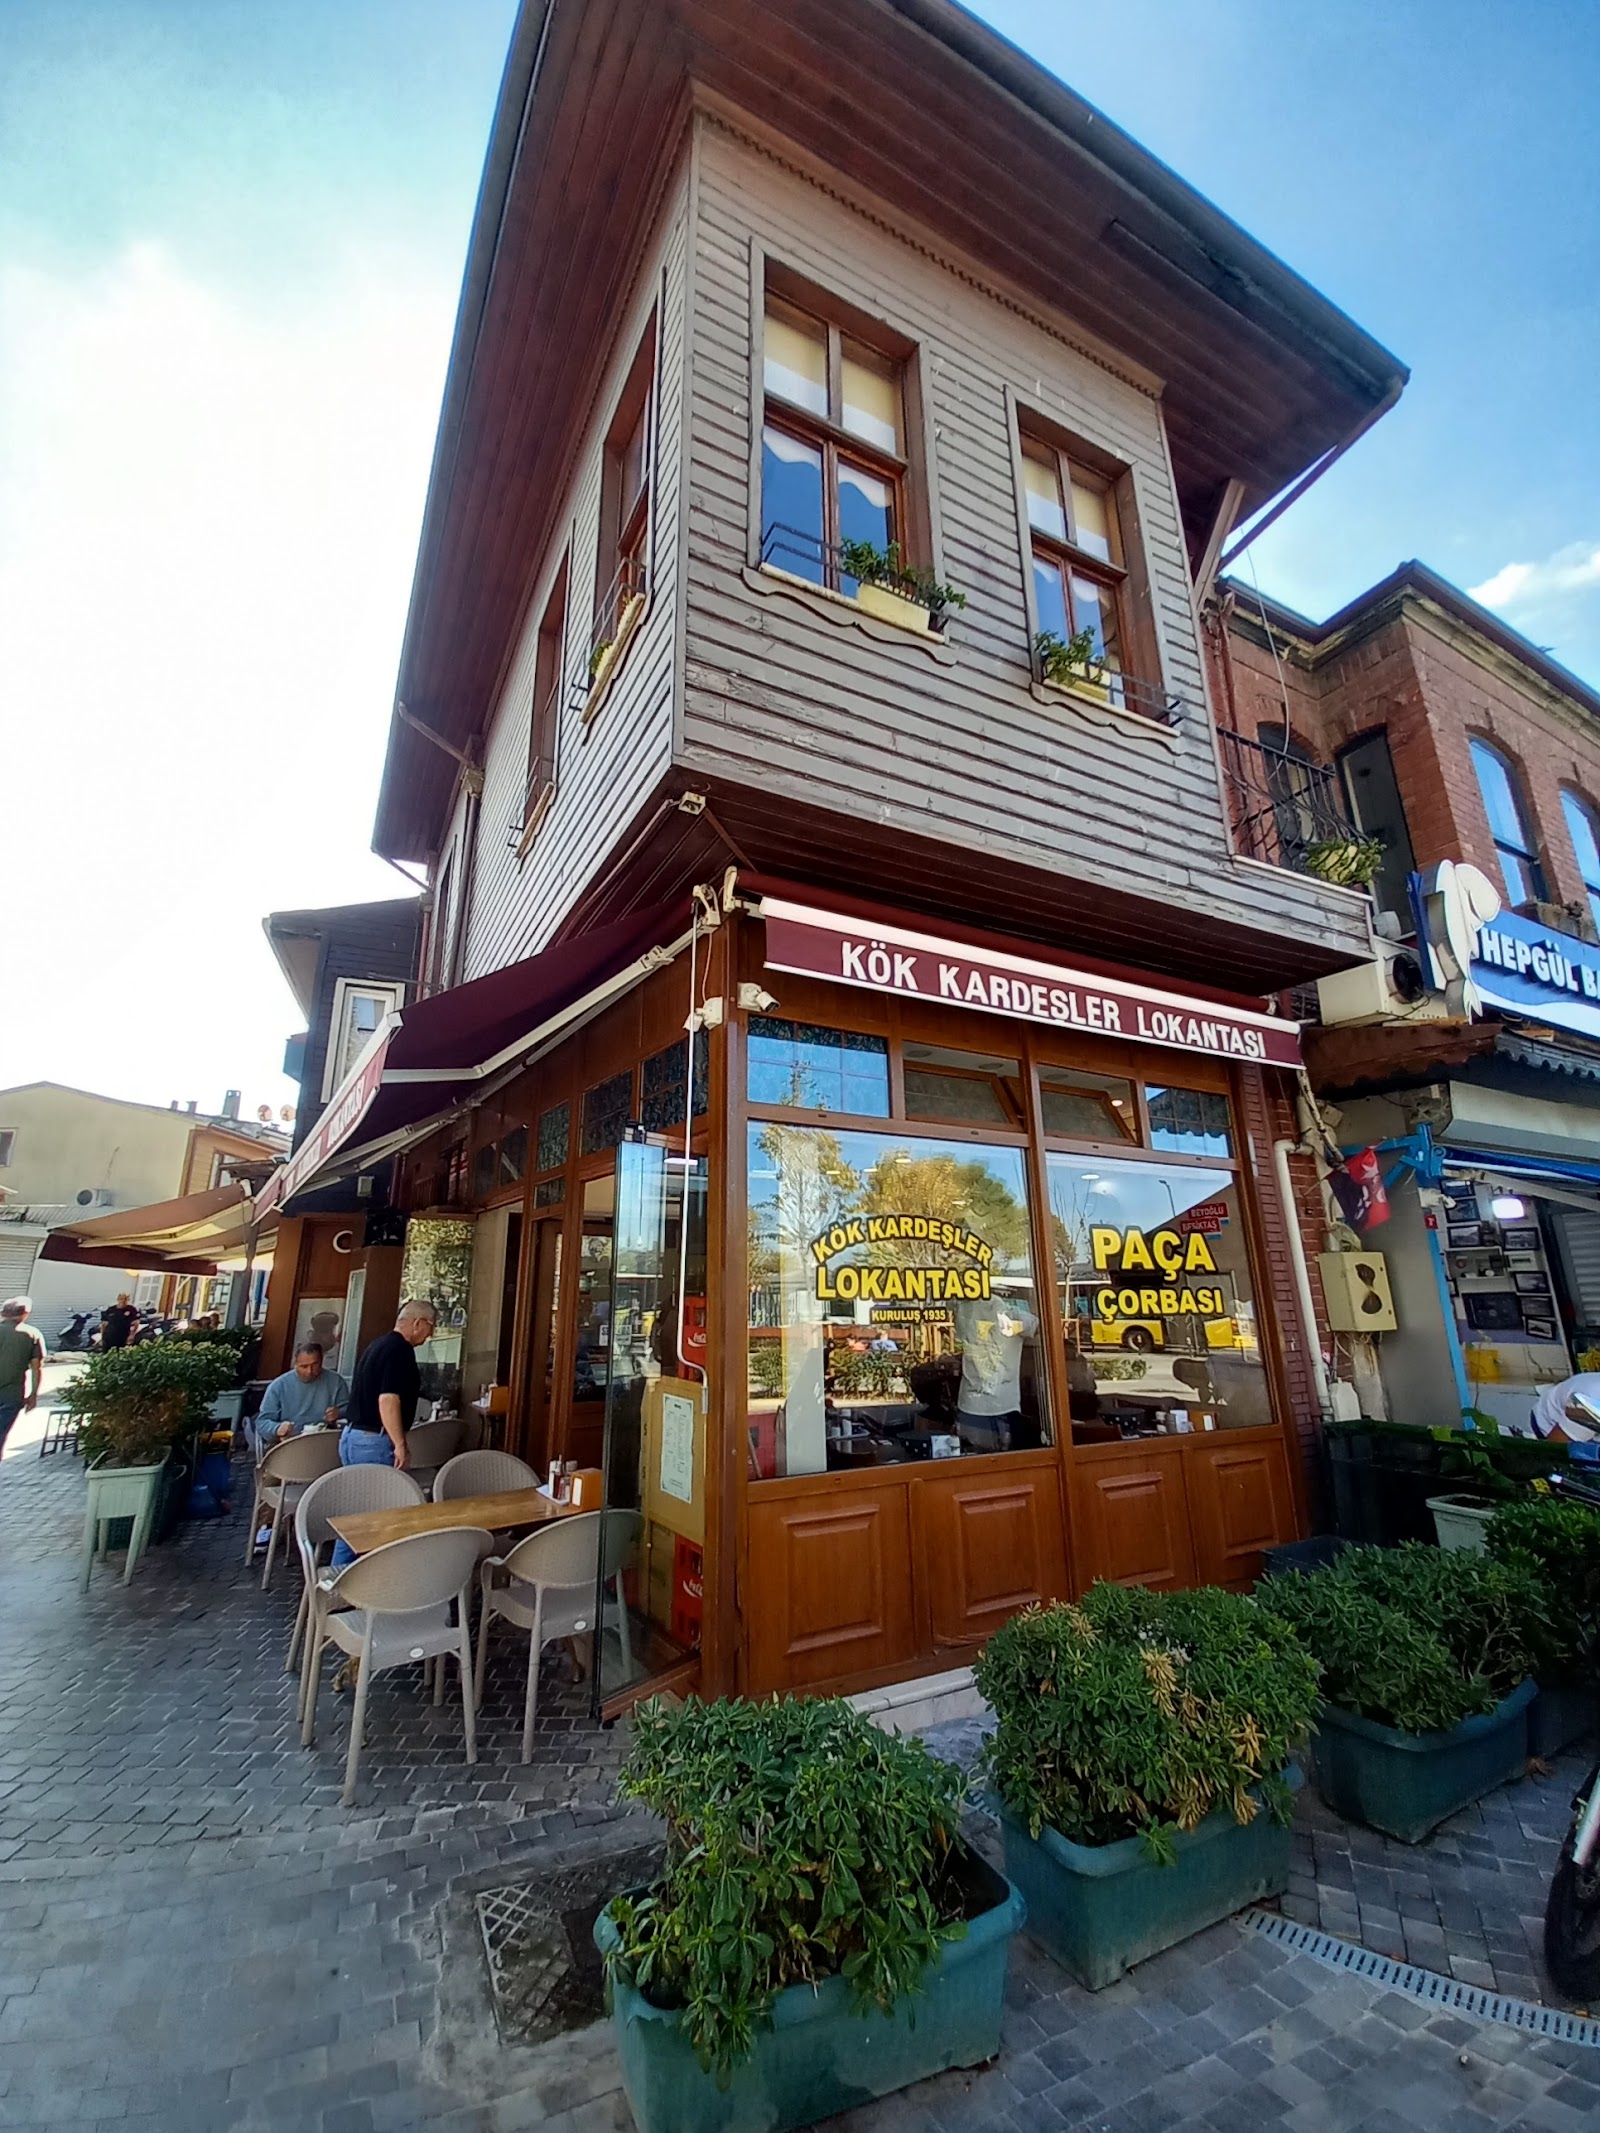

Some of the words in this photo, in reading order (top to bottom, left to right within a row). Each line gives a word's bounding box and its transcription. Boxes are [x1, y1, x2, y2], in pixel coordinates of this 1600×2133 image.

[1480, 926, 1579, 992] HEPGÜL
[1580, 963, 1600, 1000] B
[842, 941, 919, 991] KÖK
[1136, 1006, 1266, 1058] LOKANTASI
[812, 1219, 864, 1264] KÖK
[867, 1216, 993, 1268] KARDEŞLER
[1091, 1227, 1217, 1281] PAÇA
[816, 1266, 990, 1300] LOKANTASI
[1097, 1288, 1223, 1323] ÇORBASI
[871, 1309, 920, 1324] KURULUŞ
[922, 1309, 946, 1321] 1935
